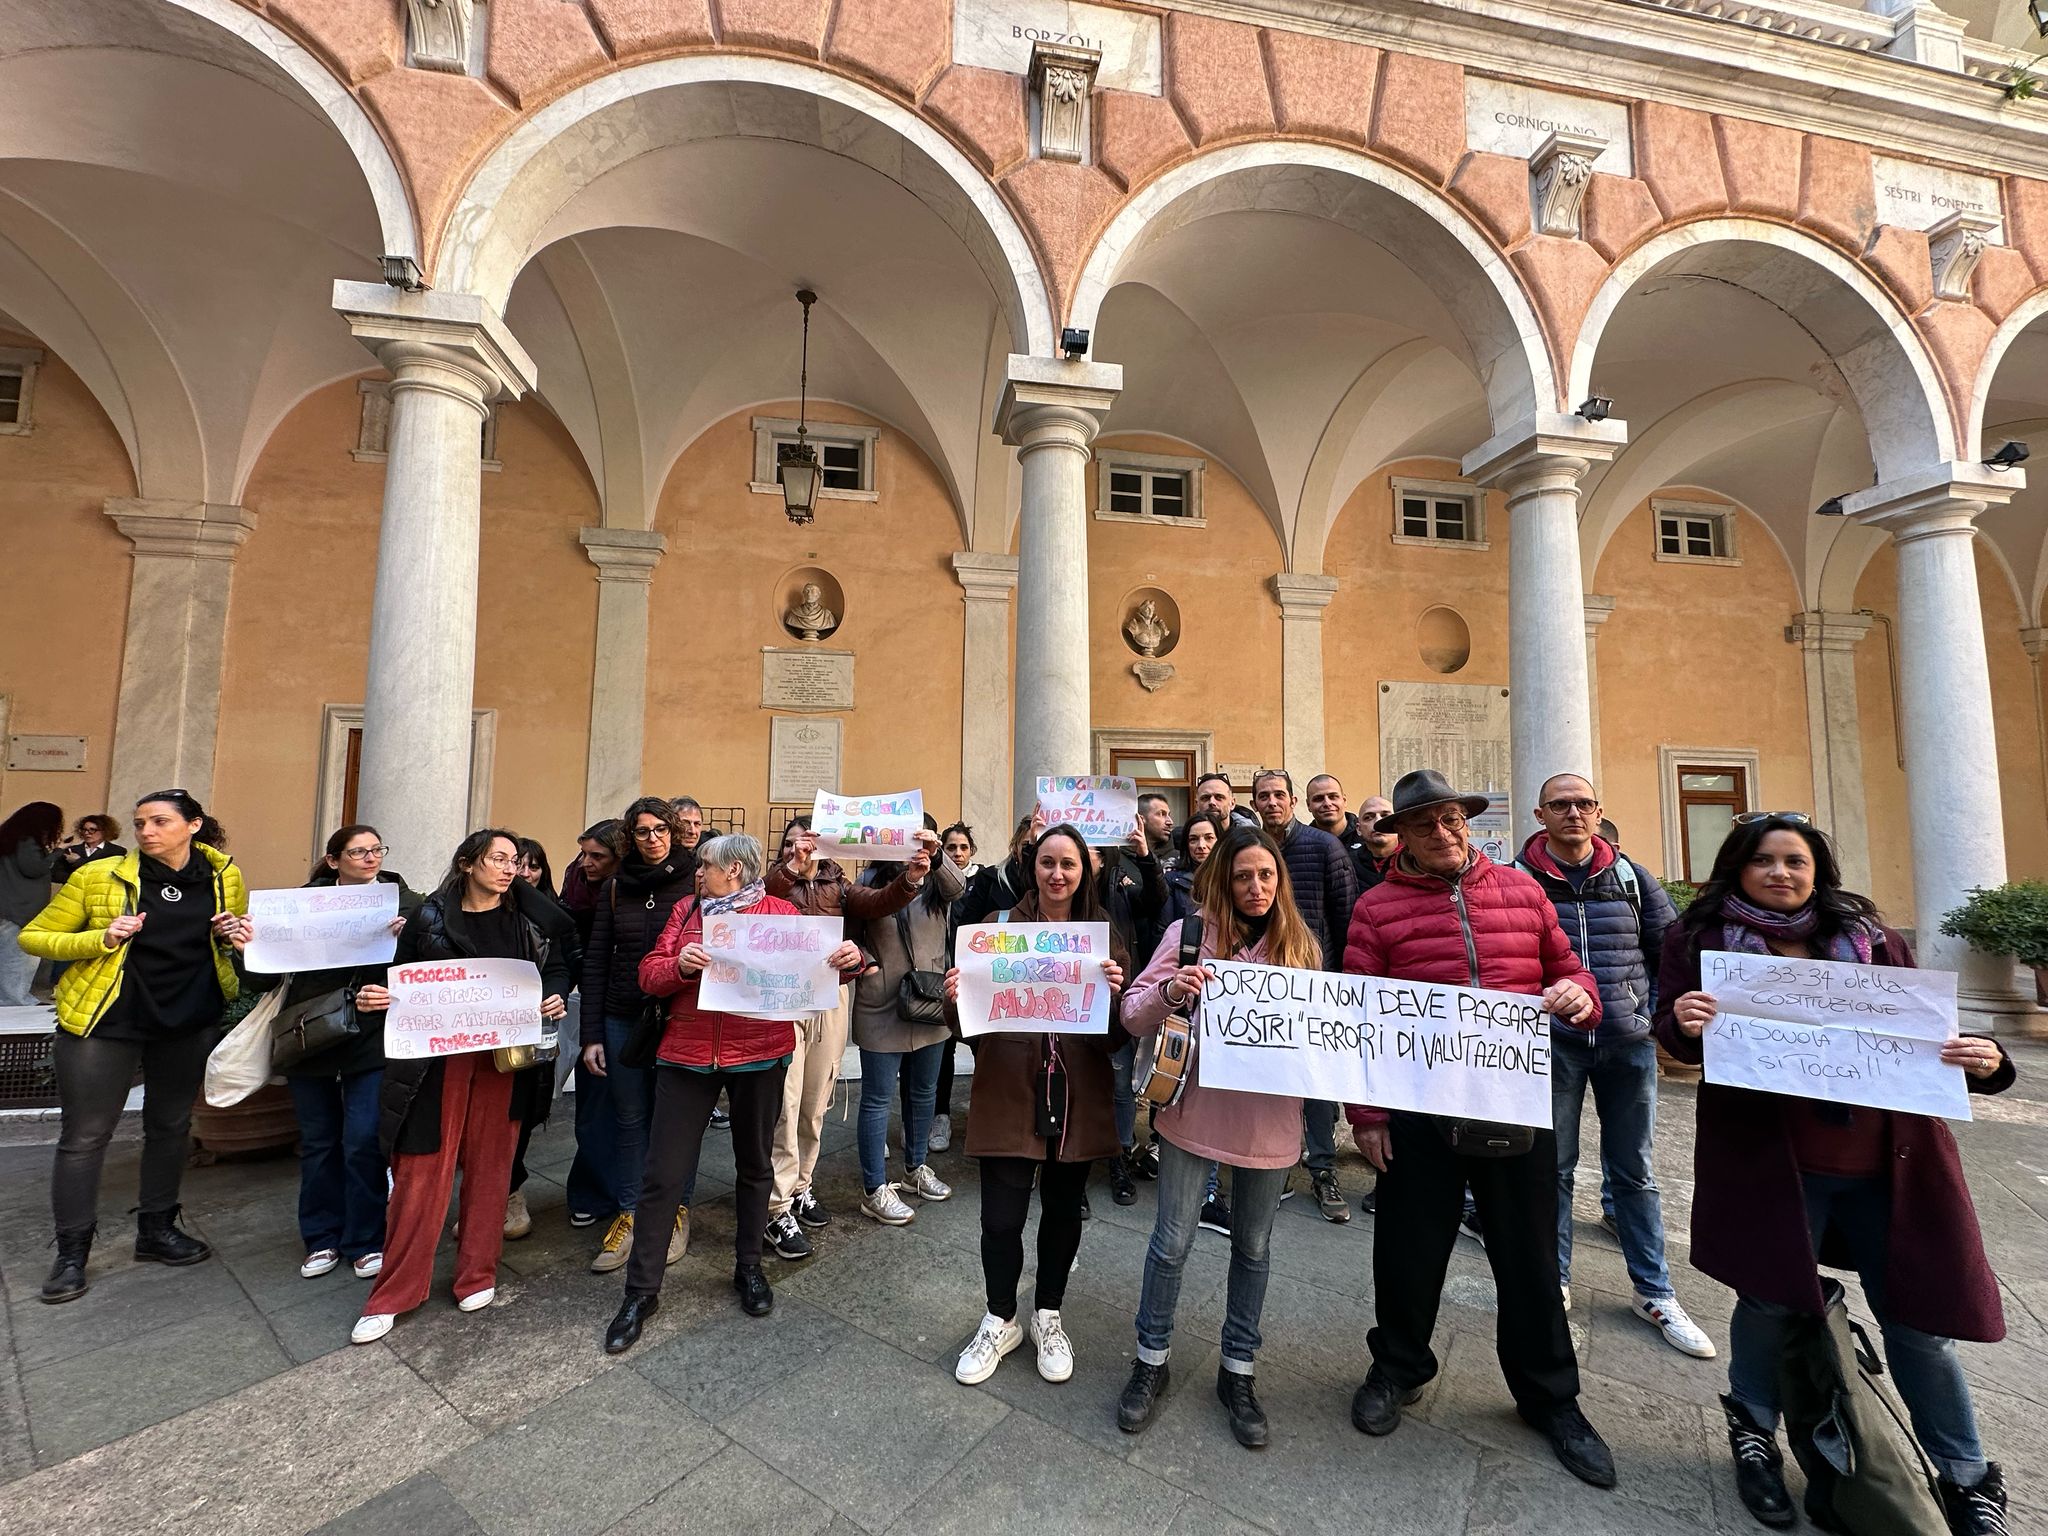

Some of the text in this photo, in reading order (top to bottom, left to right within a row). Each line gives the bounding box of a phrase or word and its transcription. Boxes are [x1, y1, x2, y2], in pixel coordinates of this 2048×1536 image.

[1884, 186, 1984, 211] SESTRI PONENTE
[1039, 777, 1131, 794] RIVOGLIAMO
[1071, 792, 1094, 806] LA
[711, 922, 820, 954] SI SCUOLA
[968, 930, 1092, 954] SENZA SCUOLA
[708, 960, 741, 984] NO
[991, 956, 1082, 985] BORZOLI
[1765, 964, 1835, 991] 33-34
[1844, 969, 1909, 996] della
[438, 986, 493, 1006] SICURO
[502, 985, 519, 999] DI
[987, 982, 1096, 1023] MUORE!
[1204, 963, 1549, 1038] BORZOLI NON DEVE PAGARE
[1751, 990, 1900, 1017] COSTITUZIONE
[396, 1013, 443, 1032] SAPER
[1713, 1012, 1743, 1040] LA
